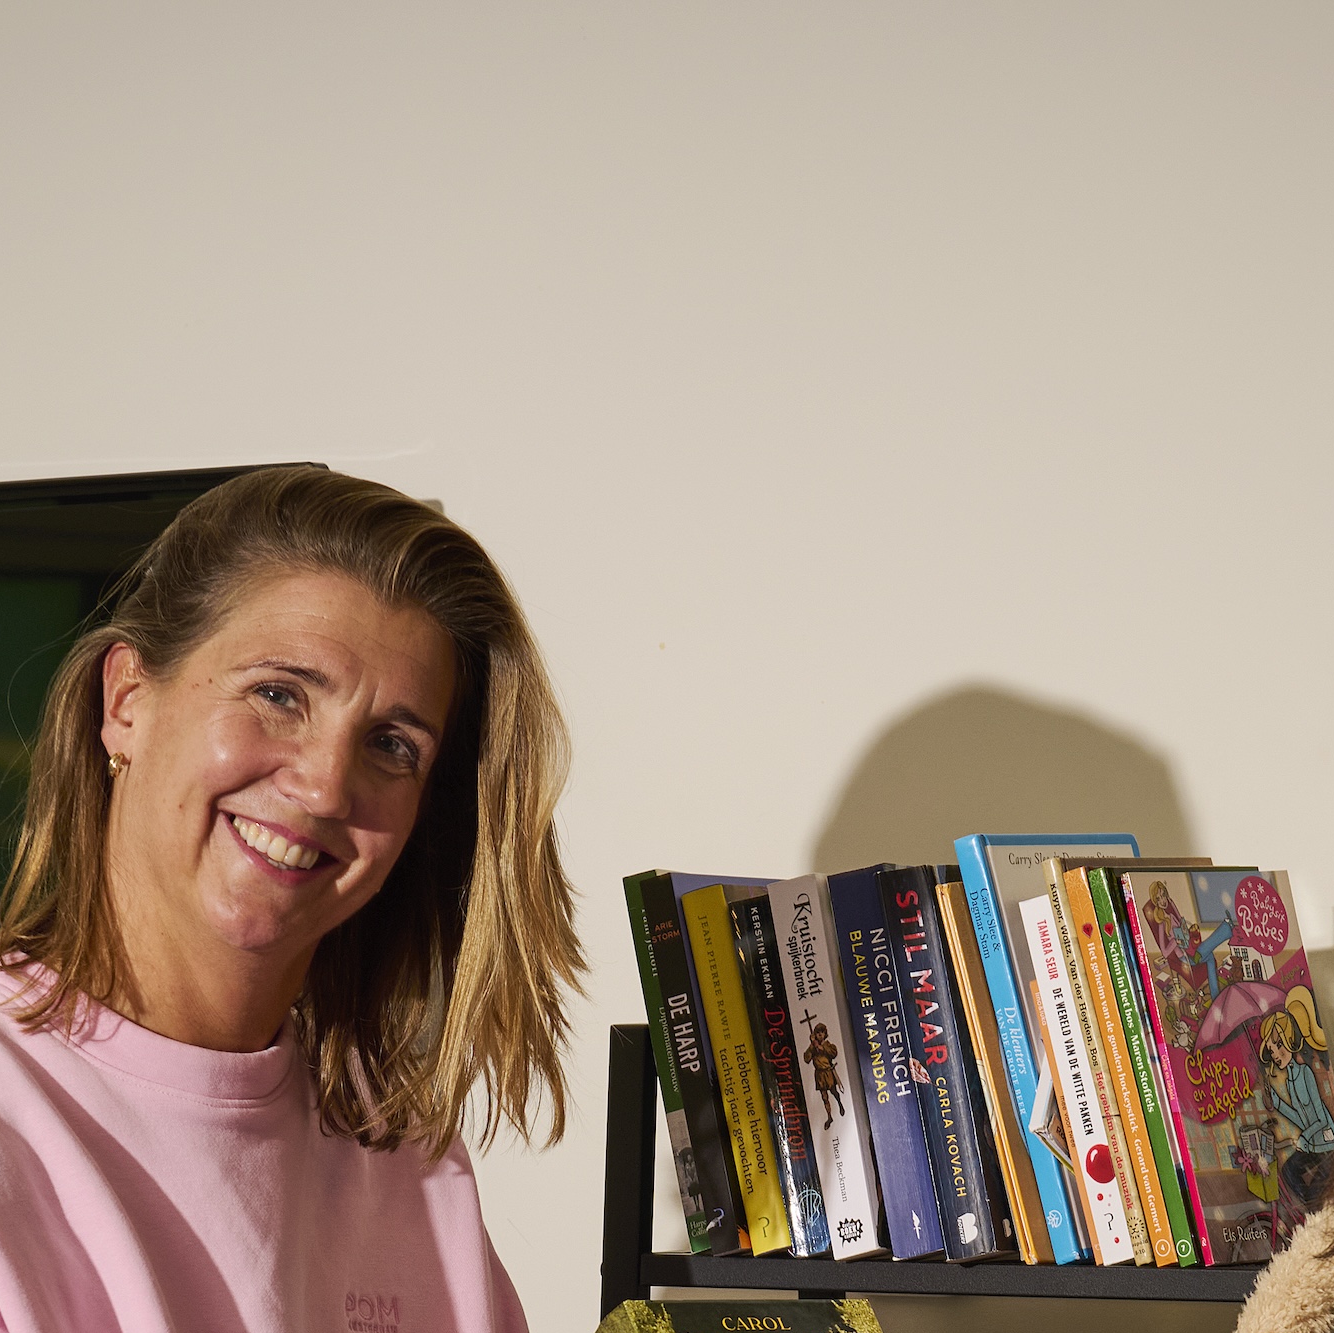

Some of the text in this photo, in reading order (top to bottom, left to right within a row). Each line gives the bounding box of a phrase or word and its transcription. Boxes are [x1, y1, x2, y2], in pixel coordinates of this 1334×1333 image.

[652, 929, 680, 944] STORM
[654, 920, 673, 931] ARIE
[750, 906, 774, 999] KERSTIN EKMAN
[790, 893, 824, 997] Kruistocht
[970, 891, 984, 932] Dagmar
[980, 933, 990, 959] Stam
[980, 887, 997, 941] Carry Slee
[1037, 919, 1059, 980] TAMARA SEUR
[1237, 905, 1284, 943] Babes
[698, 915, 731, 1041] JEAN PIERRE RAWIE
[786, 936, 809, 1001] spijkerbroek
[870, 927, 912, 1097] NICCI FRENCH
[896, 890, 948, 1066] STIL MAAR
[668, 992, 701, 1073] DE HARP
[849, 930, 890, 1104] BLAUWE MAANDAG
[1004, 1006, 1027, 1075] De kleuters
[1069, 960, 1099, 1067] Van der Bos
[1109, 942, 1154, 1113] Schim in het bos Maren Stoffels
[761, 1005, 808, 1162] De Springbron
[996, 1008, 1026, 1116] VAN DE GROTE BEER
[1052, 988, 1094, 1136] DE WERELD VAN DE WITTE PAKKEN
[1087, 942, 1162, 1233] Het geheim van de gouden hockeystick Gerard van Gemert
[1185, 1049, 1230, 1088] Chips
[1193, 1089, 1207, 1102] en
[1198, 1066, 1255, 1121] zakgeld
[719, 1048, 754, 1195] tachtig jaar gevochten
[734, 1043, 768, 1175] Hebben we hiervoor
[935, 1076, 967, 1198] CARLA KOVACH
[1095, 1072, 1133, 1210] Het geheim van de muziek
[832, 1136, 848, 1203] Thea Beckman
[1222, 1227, 1237, 1242] Els
[1237, 1226, 1268, 1241] Ruiters
[345, 1292, 400, 1325] POM
[721, 1316, 792, 1331] CAROL
